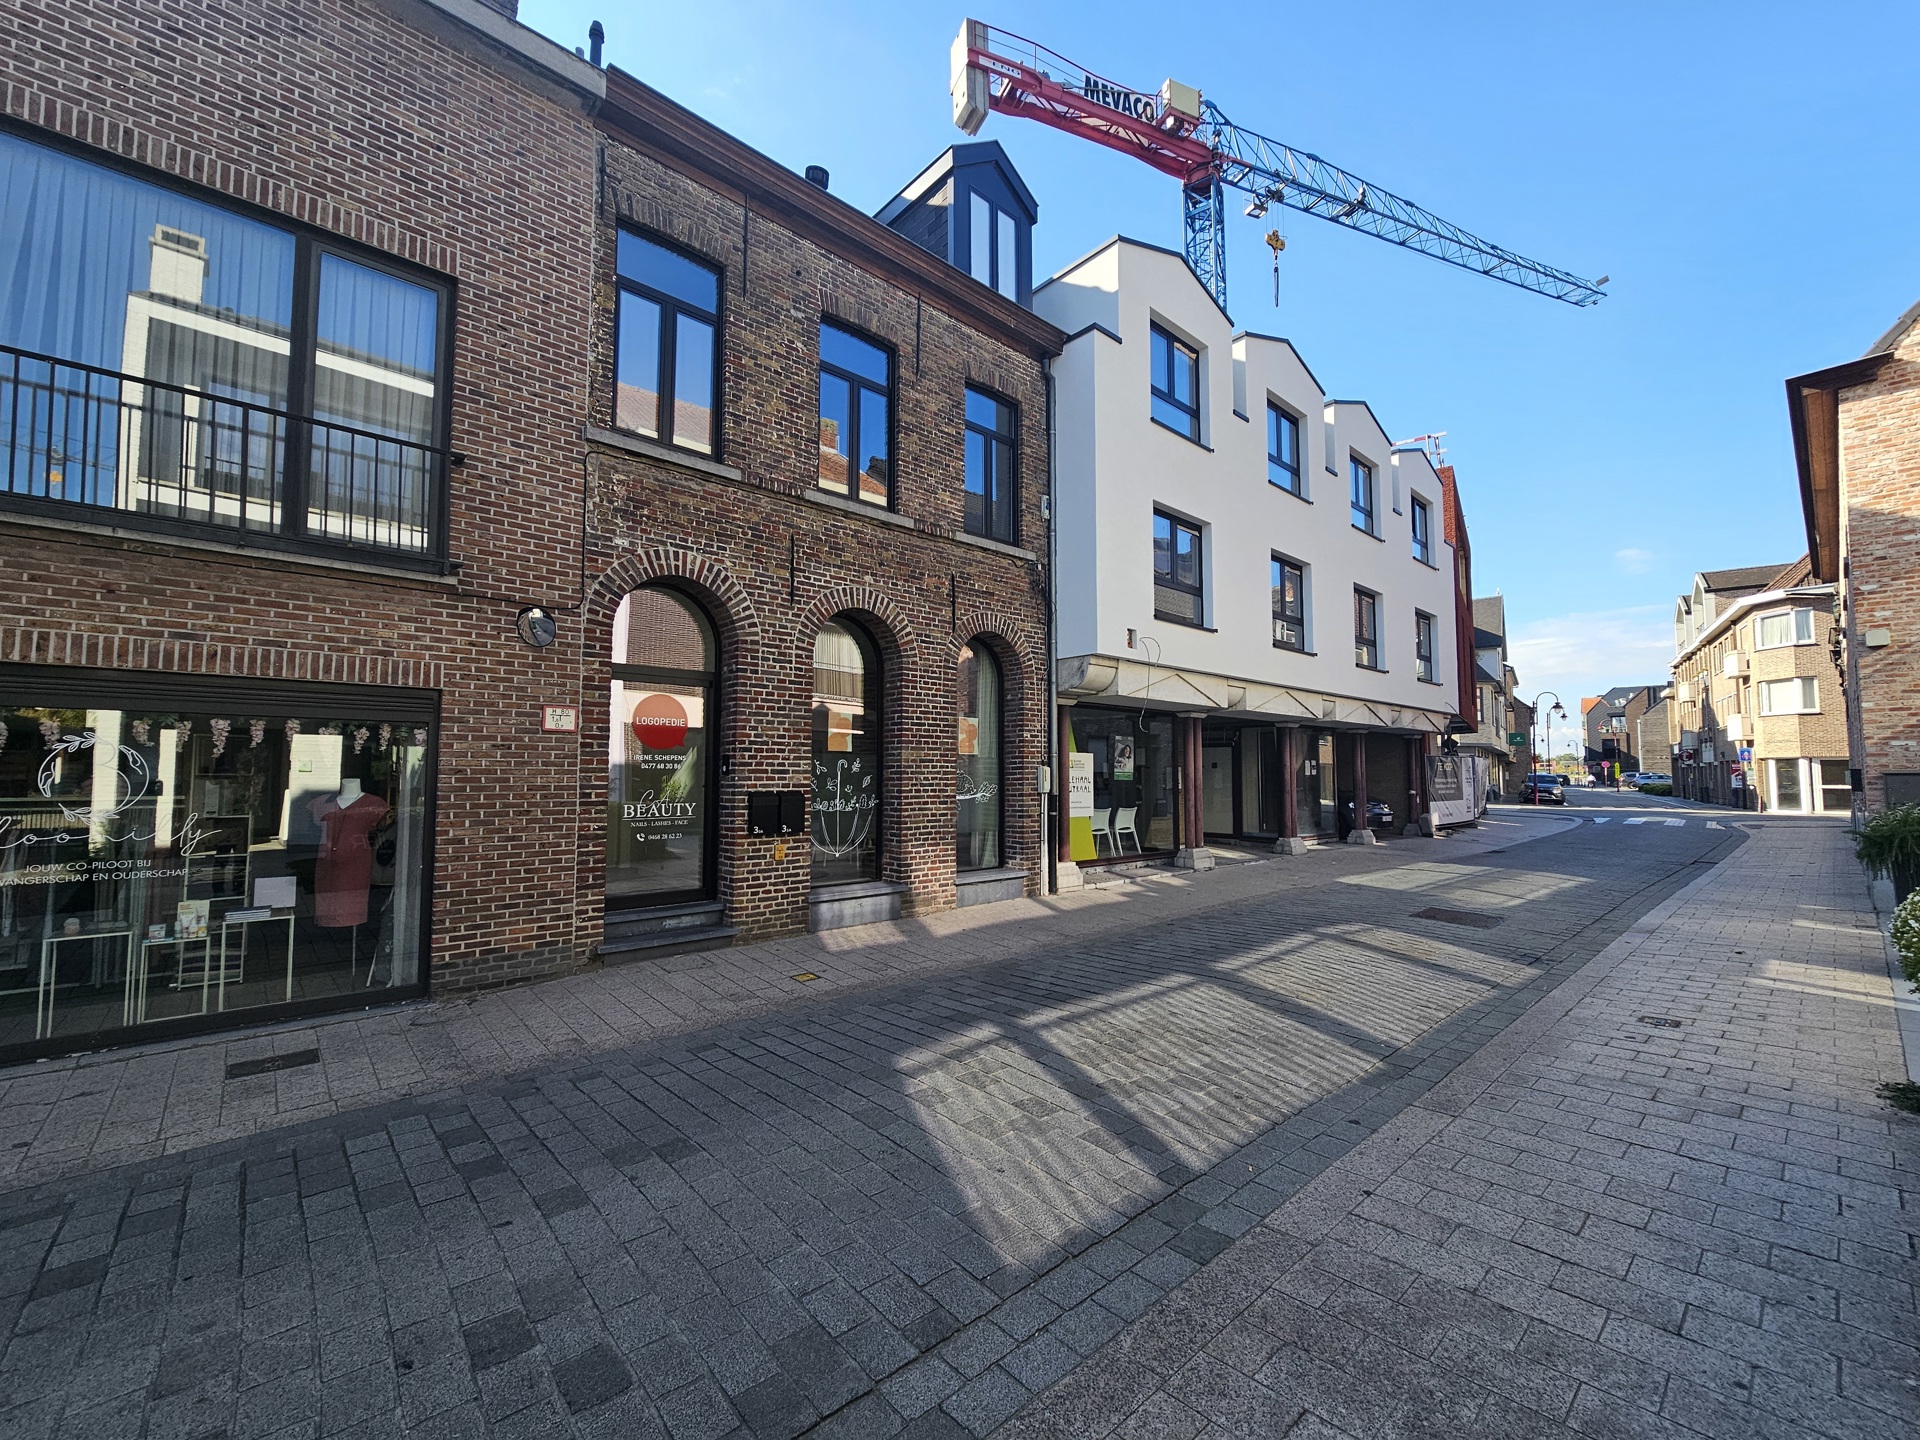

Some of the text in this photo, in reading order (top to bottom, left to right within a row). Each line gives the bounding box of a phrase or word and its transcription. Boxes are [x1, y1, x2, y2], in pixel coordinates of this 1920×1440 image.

[1084, 75, 1155, 122] MEVACO
[636, 717, 685, 726] LOGOPEDIE
[623, 802, 697, 818] BEAUTY
[24, 859, 152, 874] JOUW CO-PILOOT BIJ
[93, 872, 109, 881] EN
[112, 868, 188, 881] OUDERSCHAP
